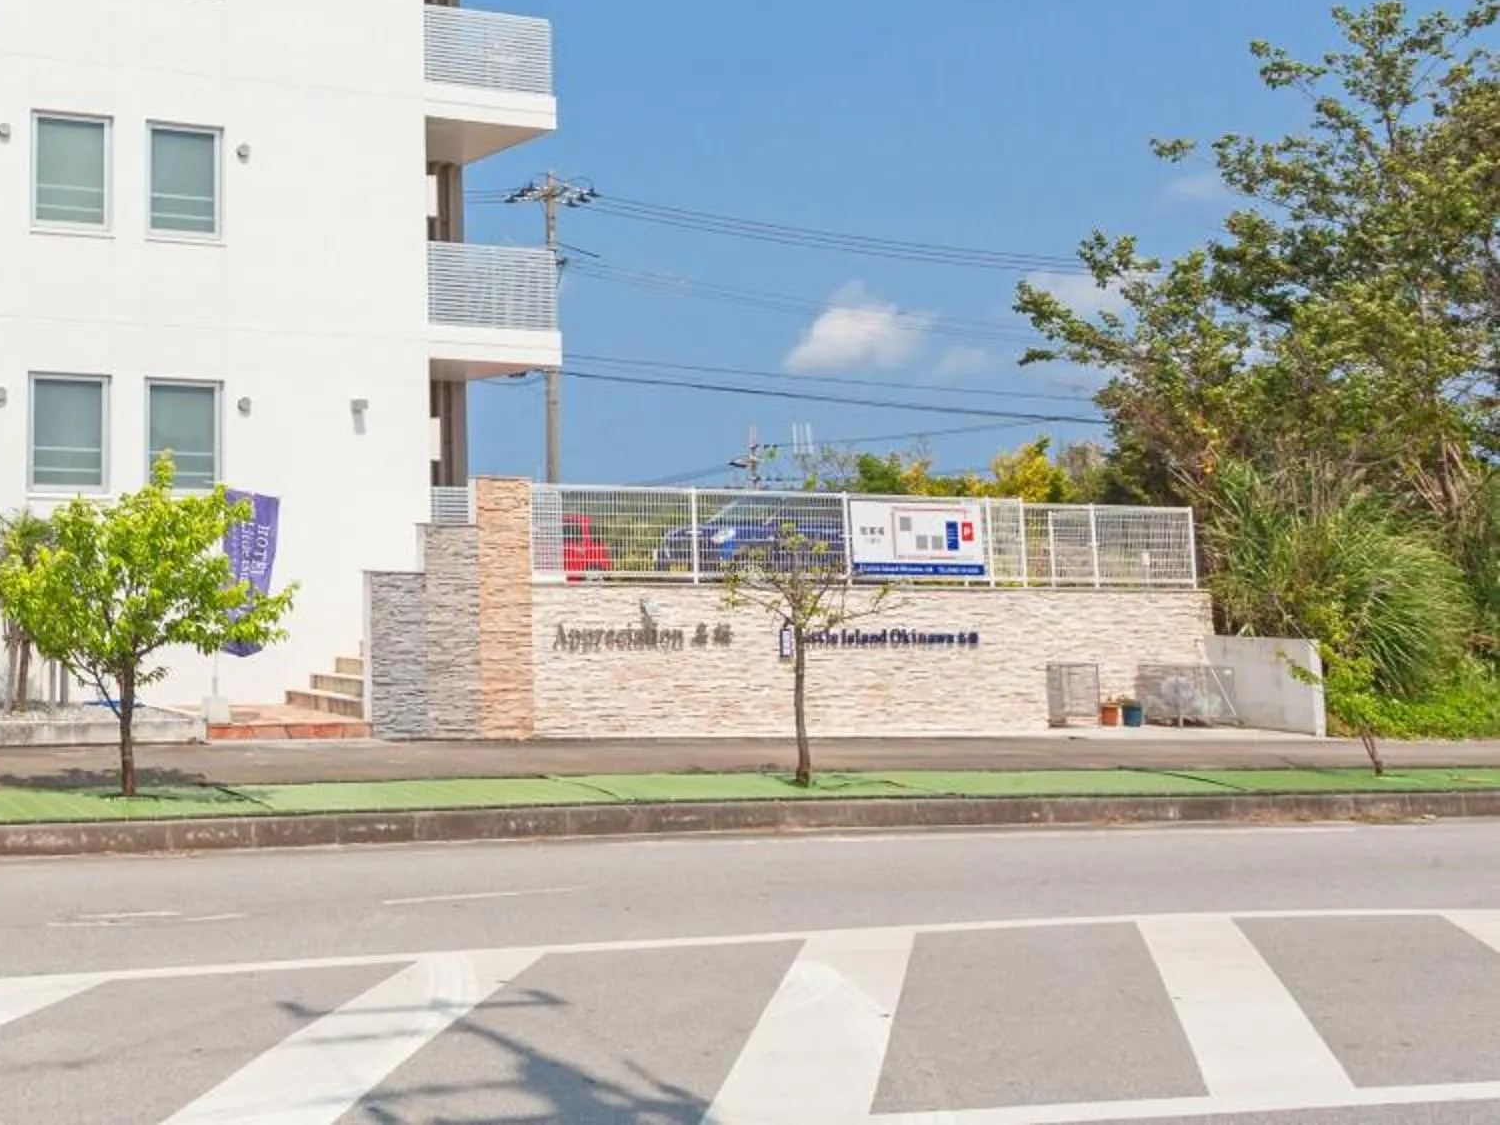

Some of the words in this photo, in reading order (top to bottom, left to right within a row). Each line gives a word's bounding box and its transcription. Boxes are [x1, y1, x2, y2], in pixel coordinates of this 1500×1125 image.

[553, 623, 685, 652] Appreciation
[841, 629, 887, 644] Island
[890, 629, 955, 644] Okinawa
